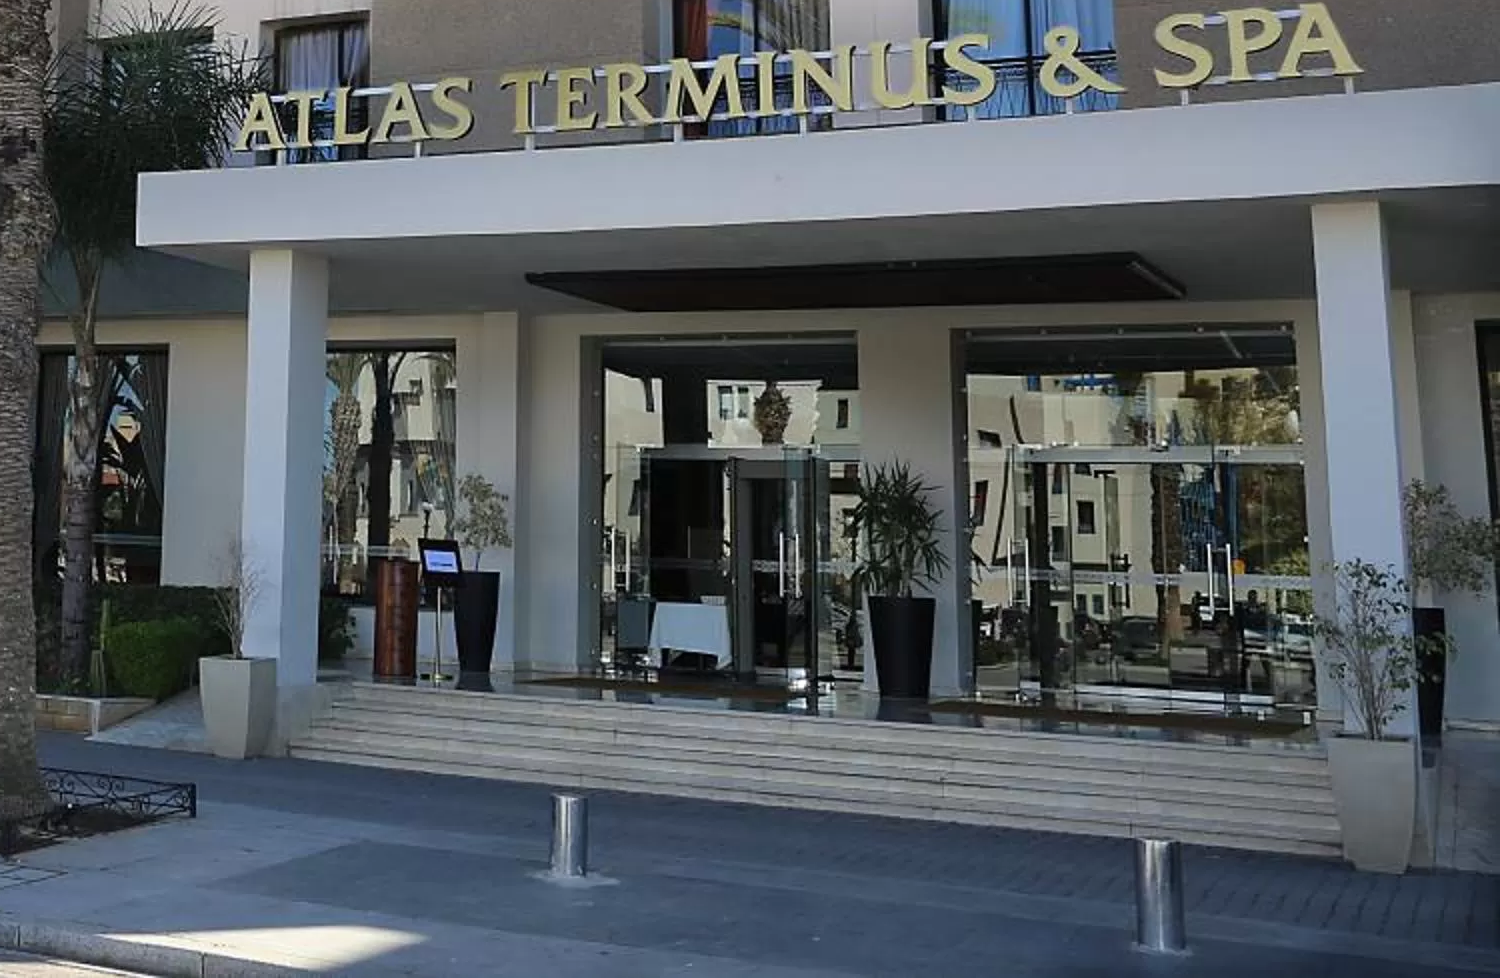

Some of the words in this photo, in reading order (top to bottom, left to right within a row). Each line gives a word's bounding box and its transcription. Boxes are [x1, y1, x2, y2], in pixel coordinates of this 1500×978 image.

[232, 77, 474, 151] ATLAS
[501, 34, 996, 134] TERMINUS
[1038, 27, 1127, 97] &
[1154, 2, 1365, 88] SPA
